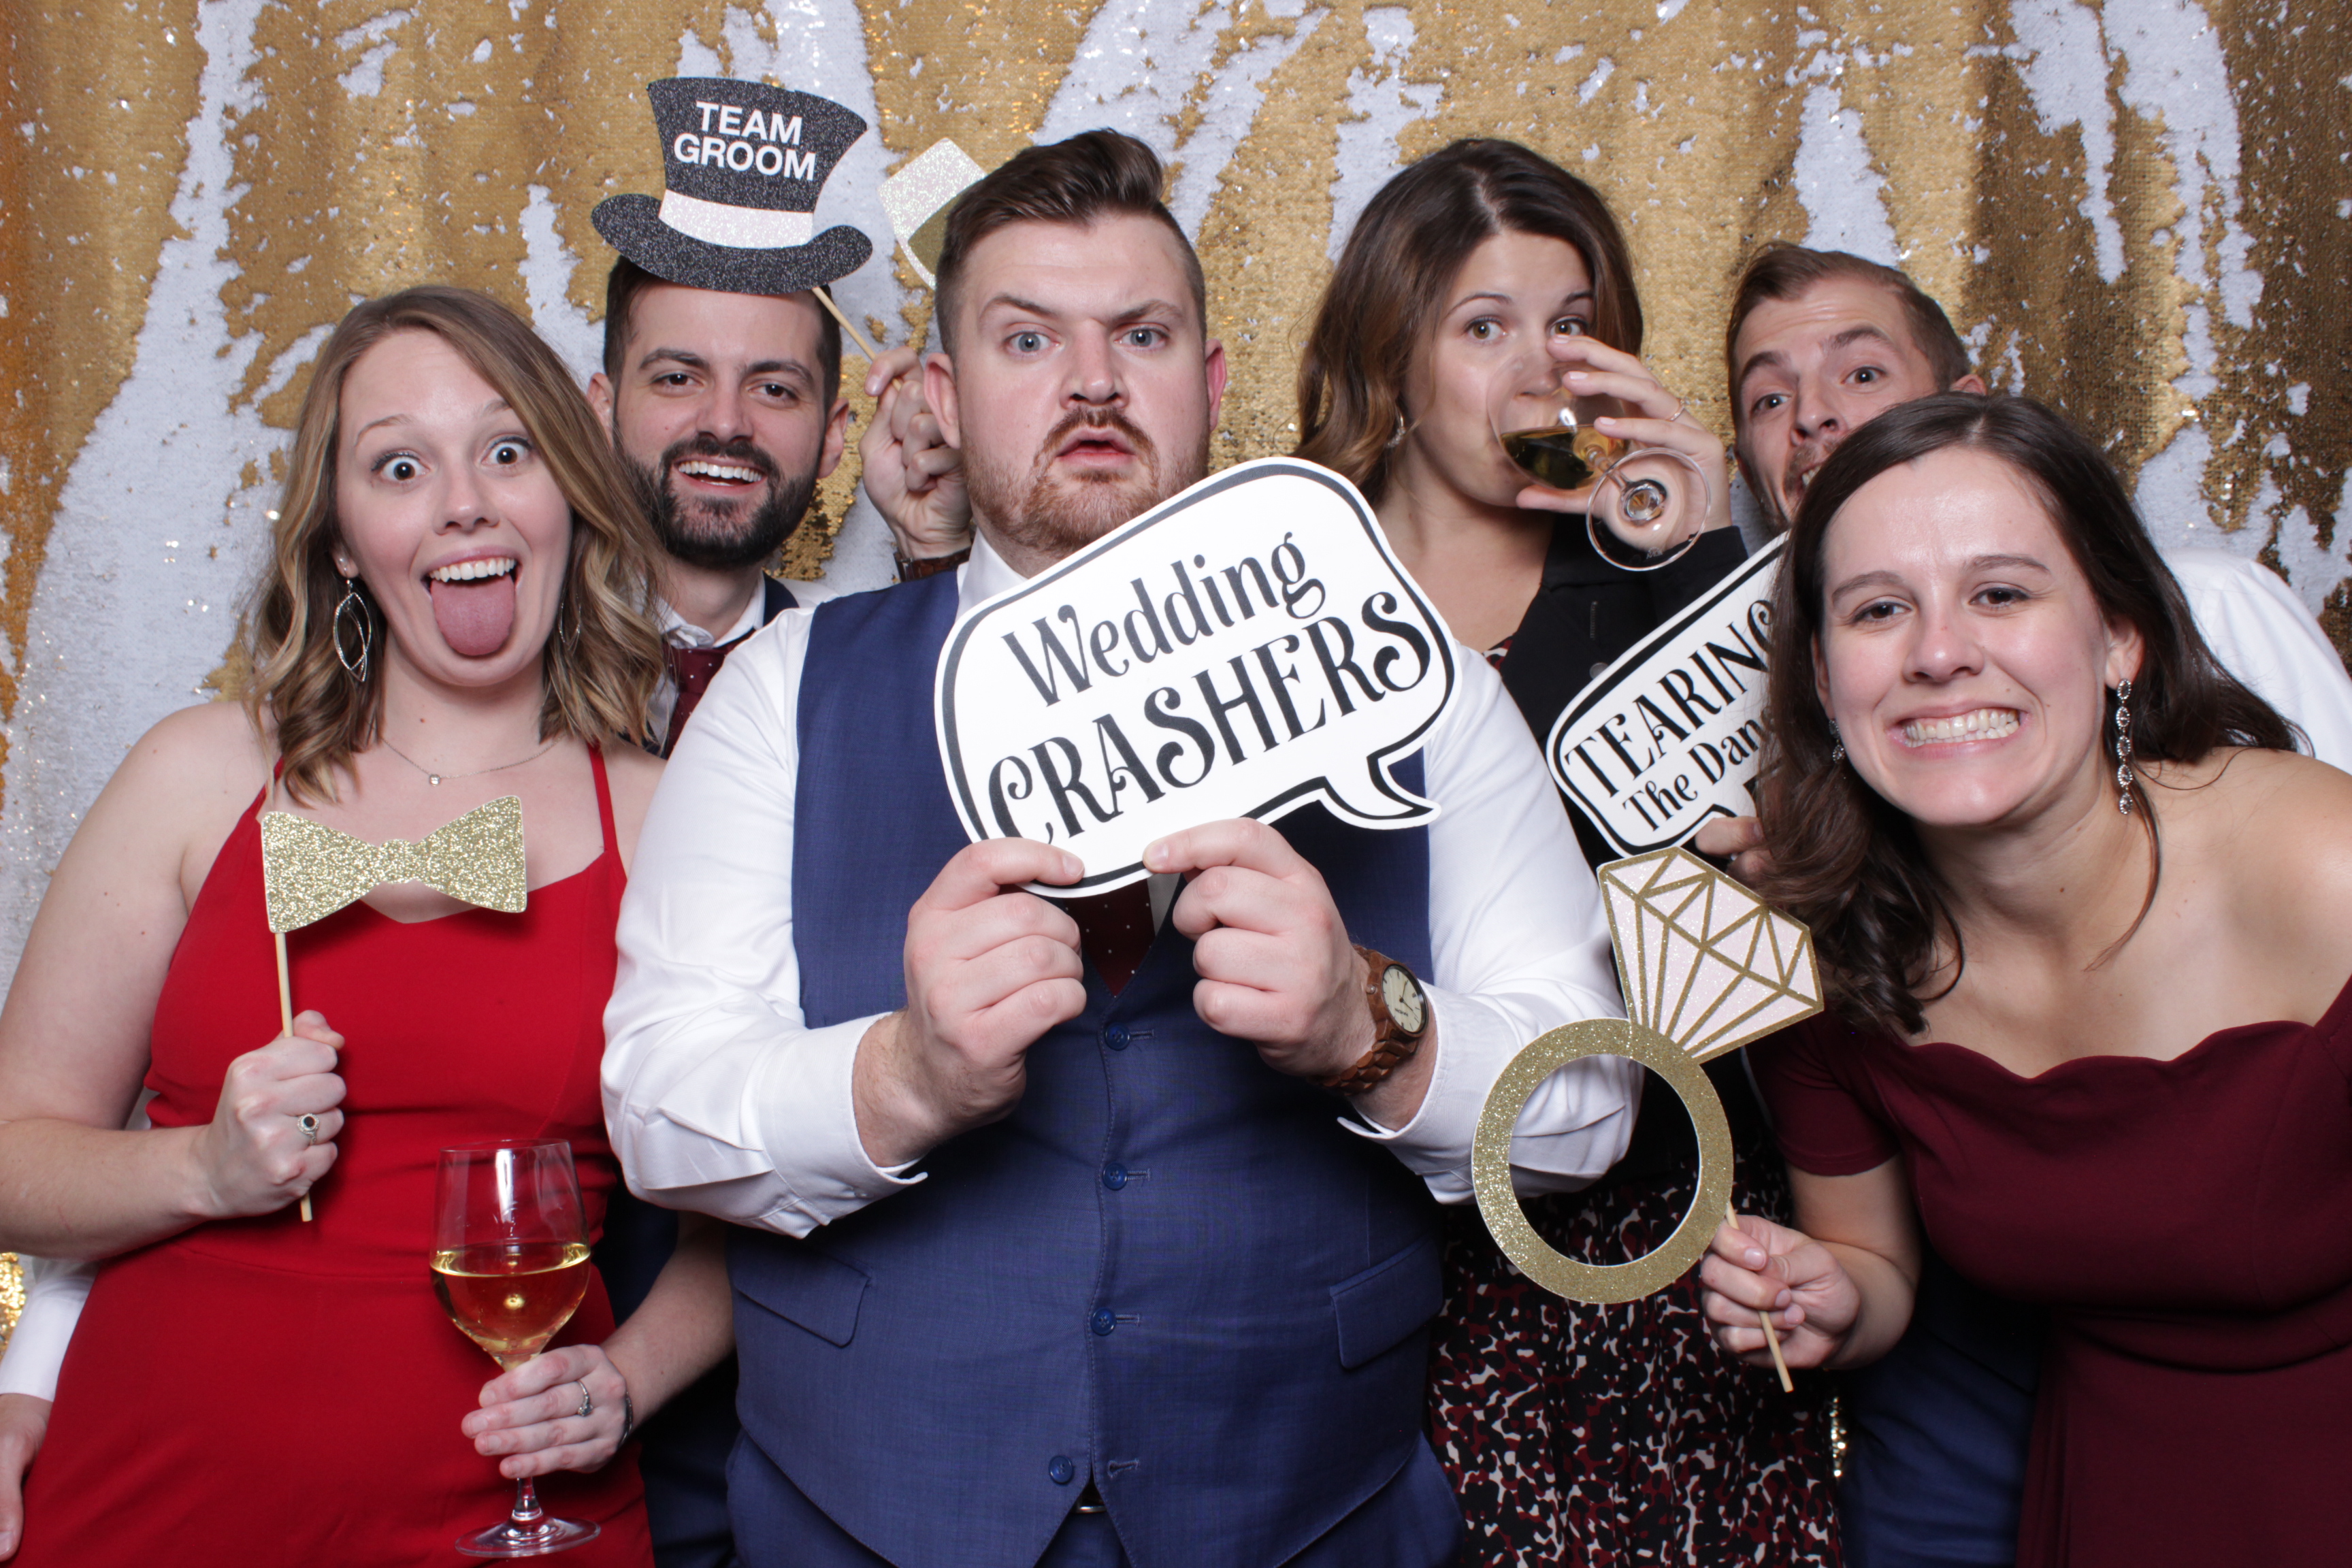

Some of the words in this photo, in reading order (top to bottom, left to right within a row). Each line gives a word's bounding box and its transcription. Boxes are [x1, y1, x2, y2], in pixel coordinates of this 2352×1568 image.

[696, 101, 802, 146] TEAM
[673, 133, 817, 181] GROOM
[1001, 532, 1326, 708] Wedding
[988, 591, 1431, 846] CRASHERS
[1622, 774, 1698, 832] The
